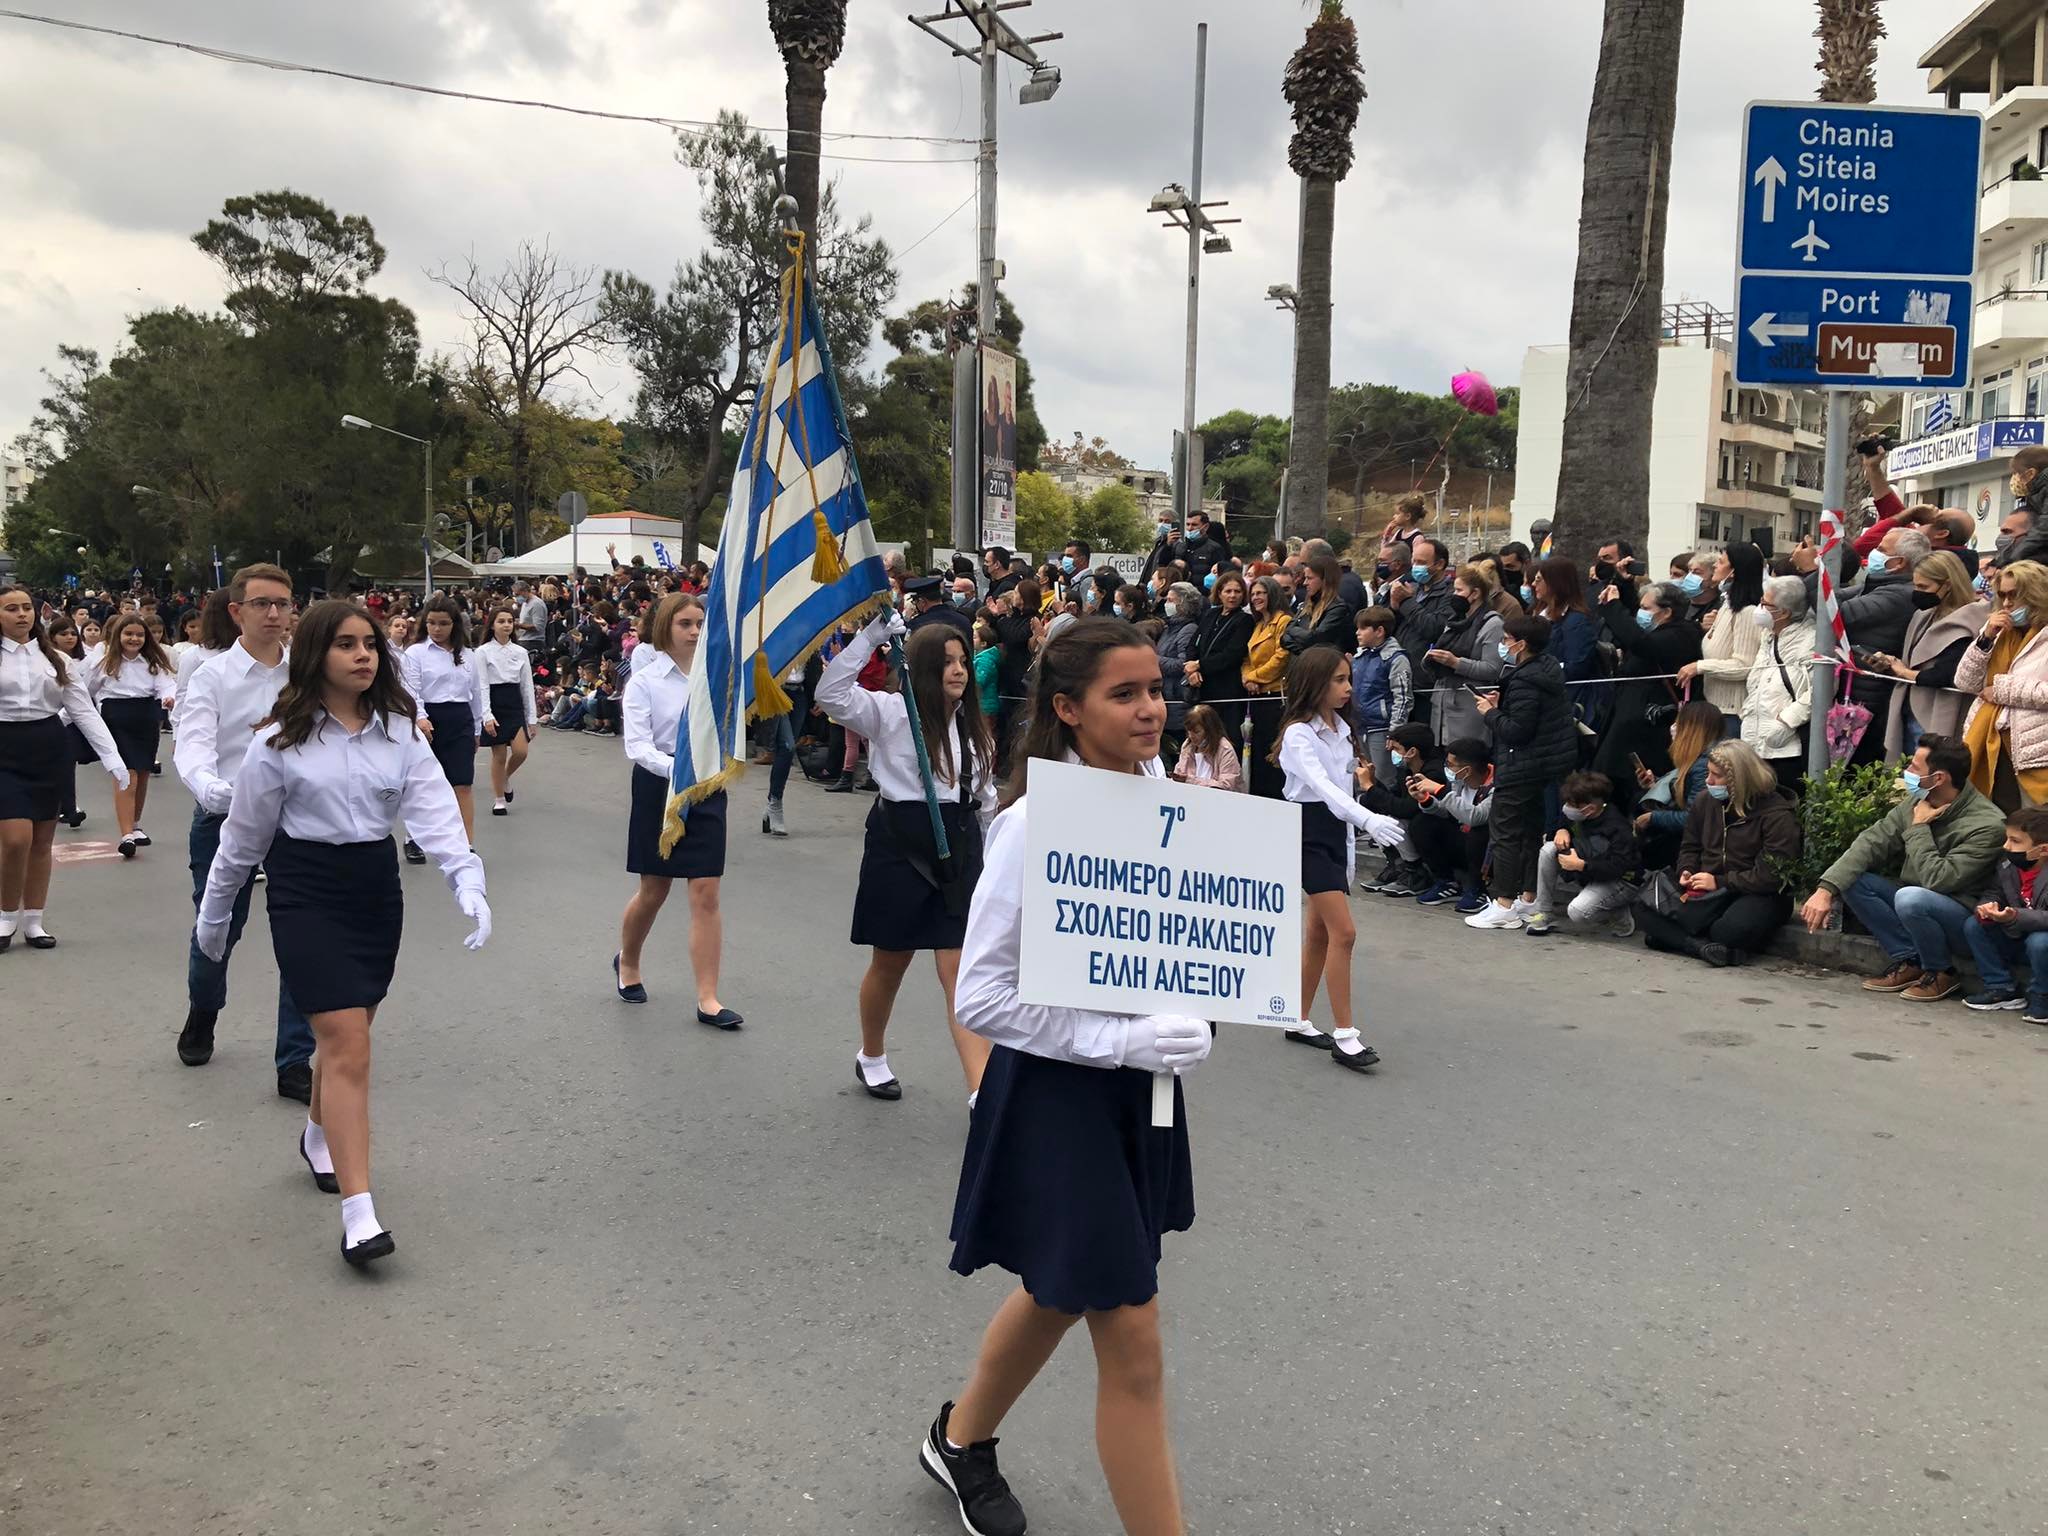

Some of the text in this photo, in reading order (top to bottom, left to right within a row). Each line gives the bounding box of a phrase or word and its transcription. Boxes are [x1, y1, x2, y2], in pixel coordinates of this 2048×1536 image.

[1799, 118, 1894, 149] Chania
[1797, 152, 1876, 181] Siteia
[1796, 186, 1890, 214] Moires
[1821, 288, 1880, 315] Port
[989, 479, 1008, 496] 27/10
[1046, 850, 1285, 914] ΟΛΟΗΜΕΡΟ ΔΗΜΟΤΙΚΟ
[1055, 898, 1276, 957] ΣΧΟΛΕΙΟ ΗΡΑΚΛΕΙΟΥ
[1089, 951, 1245, 999] ΕΛΛΗ ΑΛΕΞΙΟΥ
